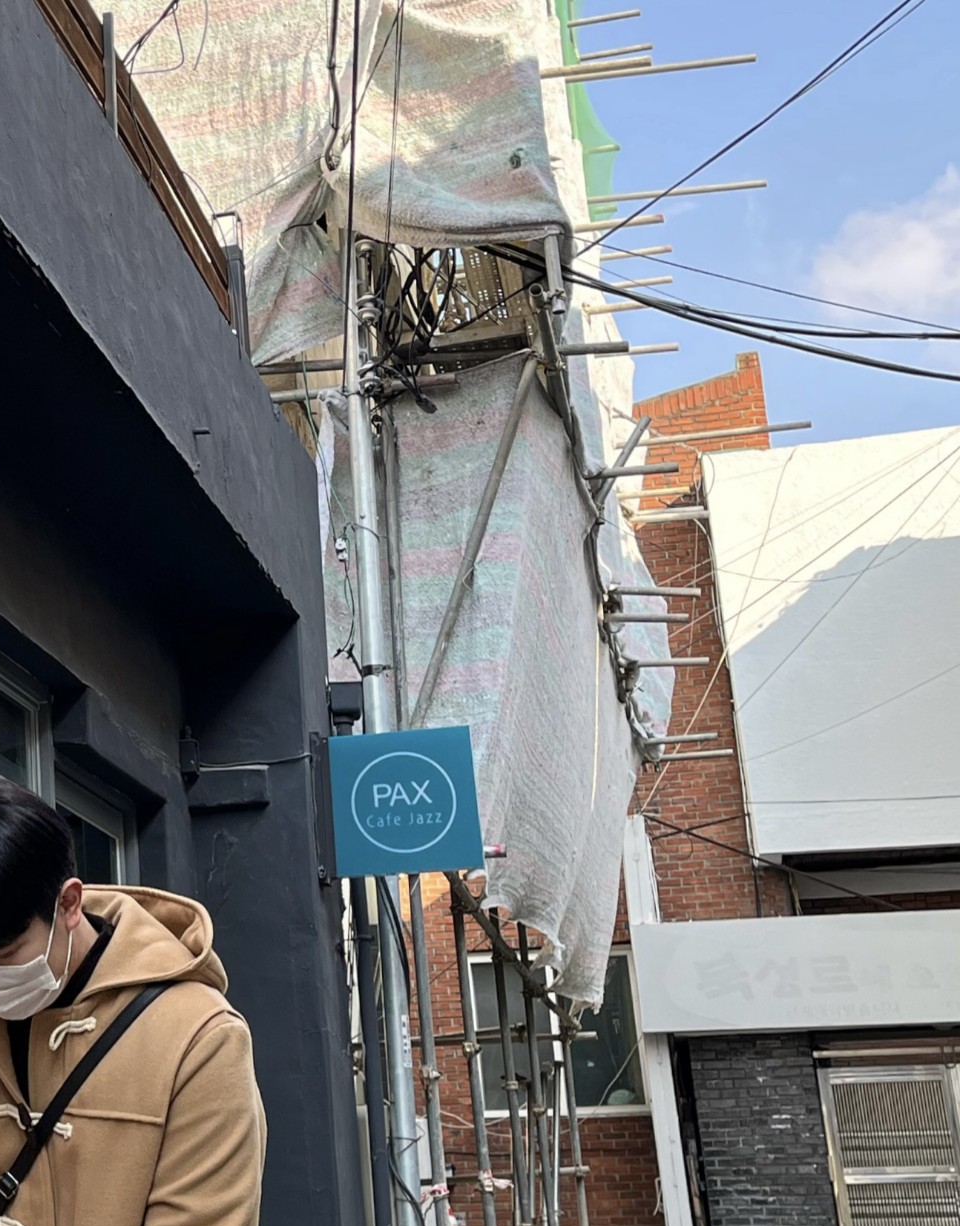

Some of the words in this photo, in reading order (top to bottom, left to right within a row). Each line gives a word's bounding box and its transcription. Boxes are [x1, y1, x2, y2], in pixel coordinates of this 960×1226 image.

[372, 779, 433, 808] PAX
[366, 812, 402, 829] Cafe
[409, 811, 443, 826] Jazz
